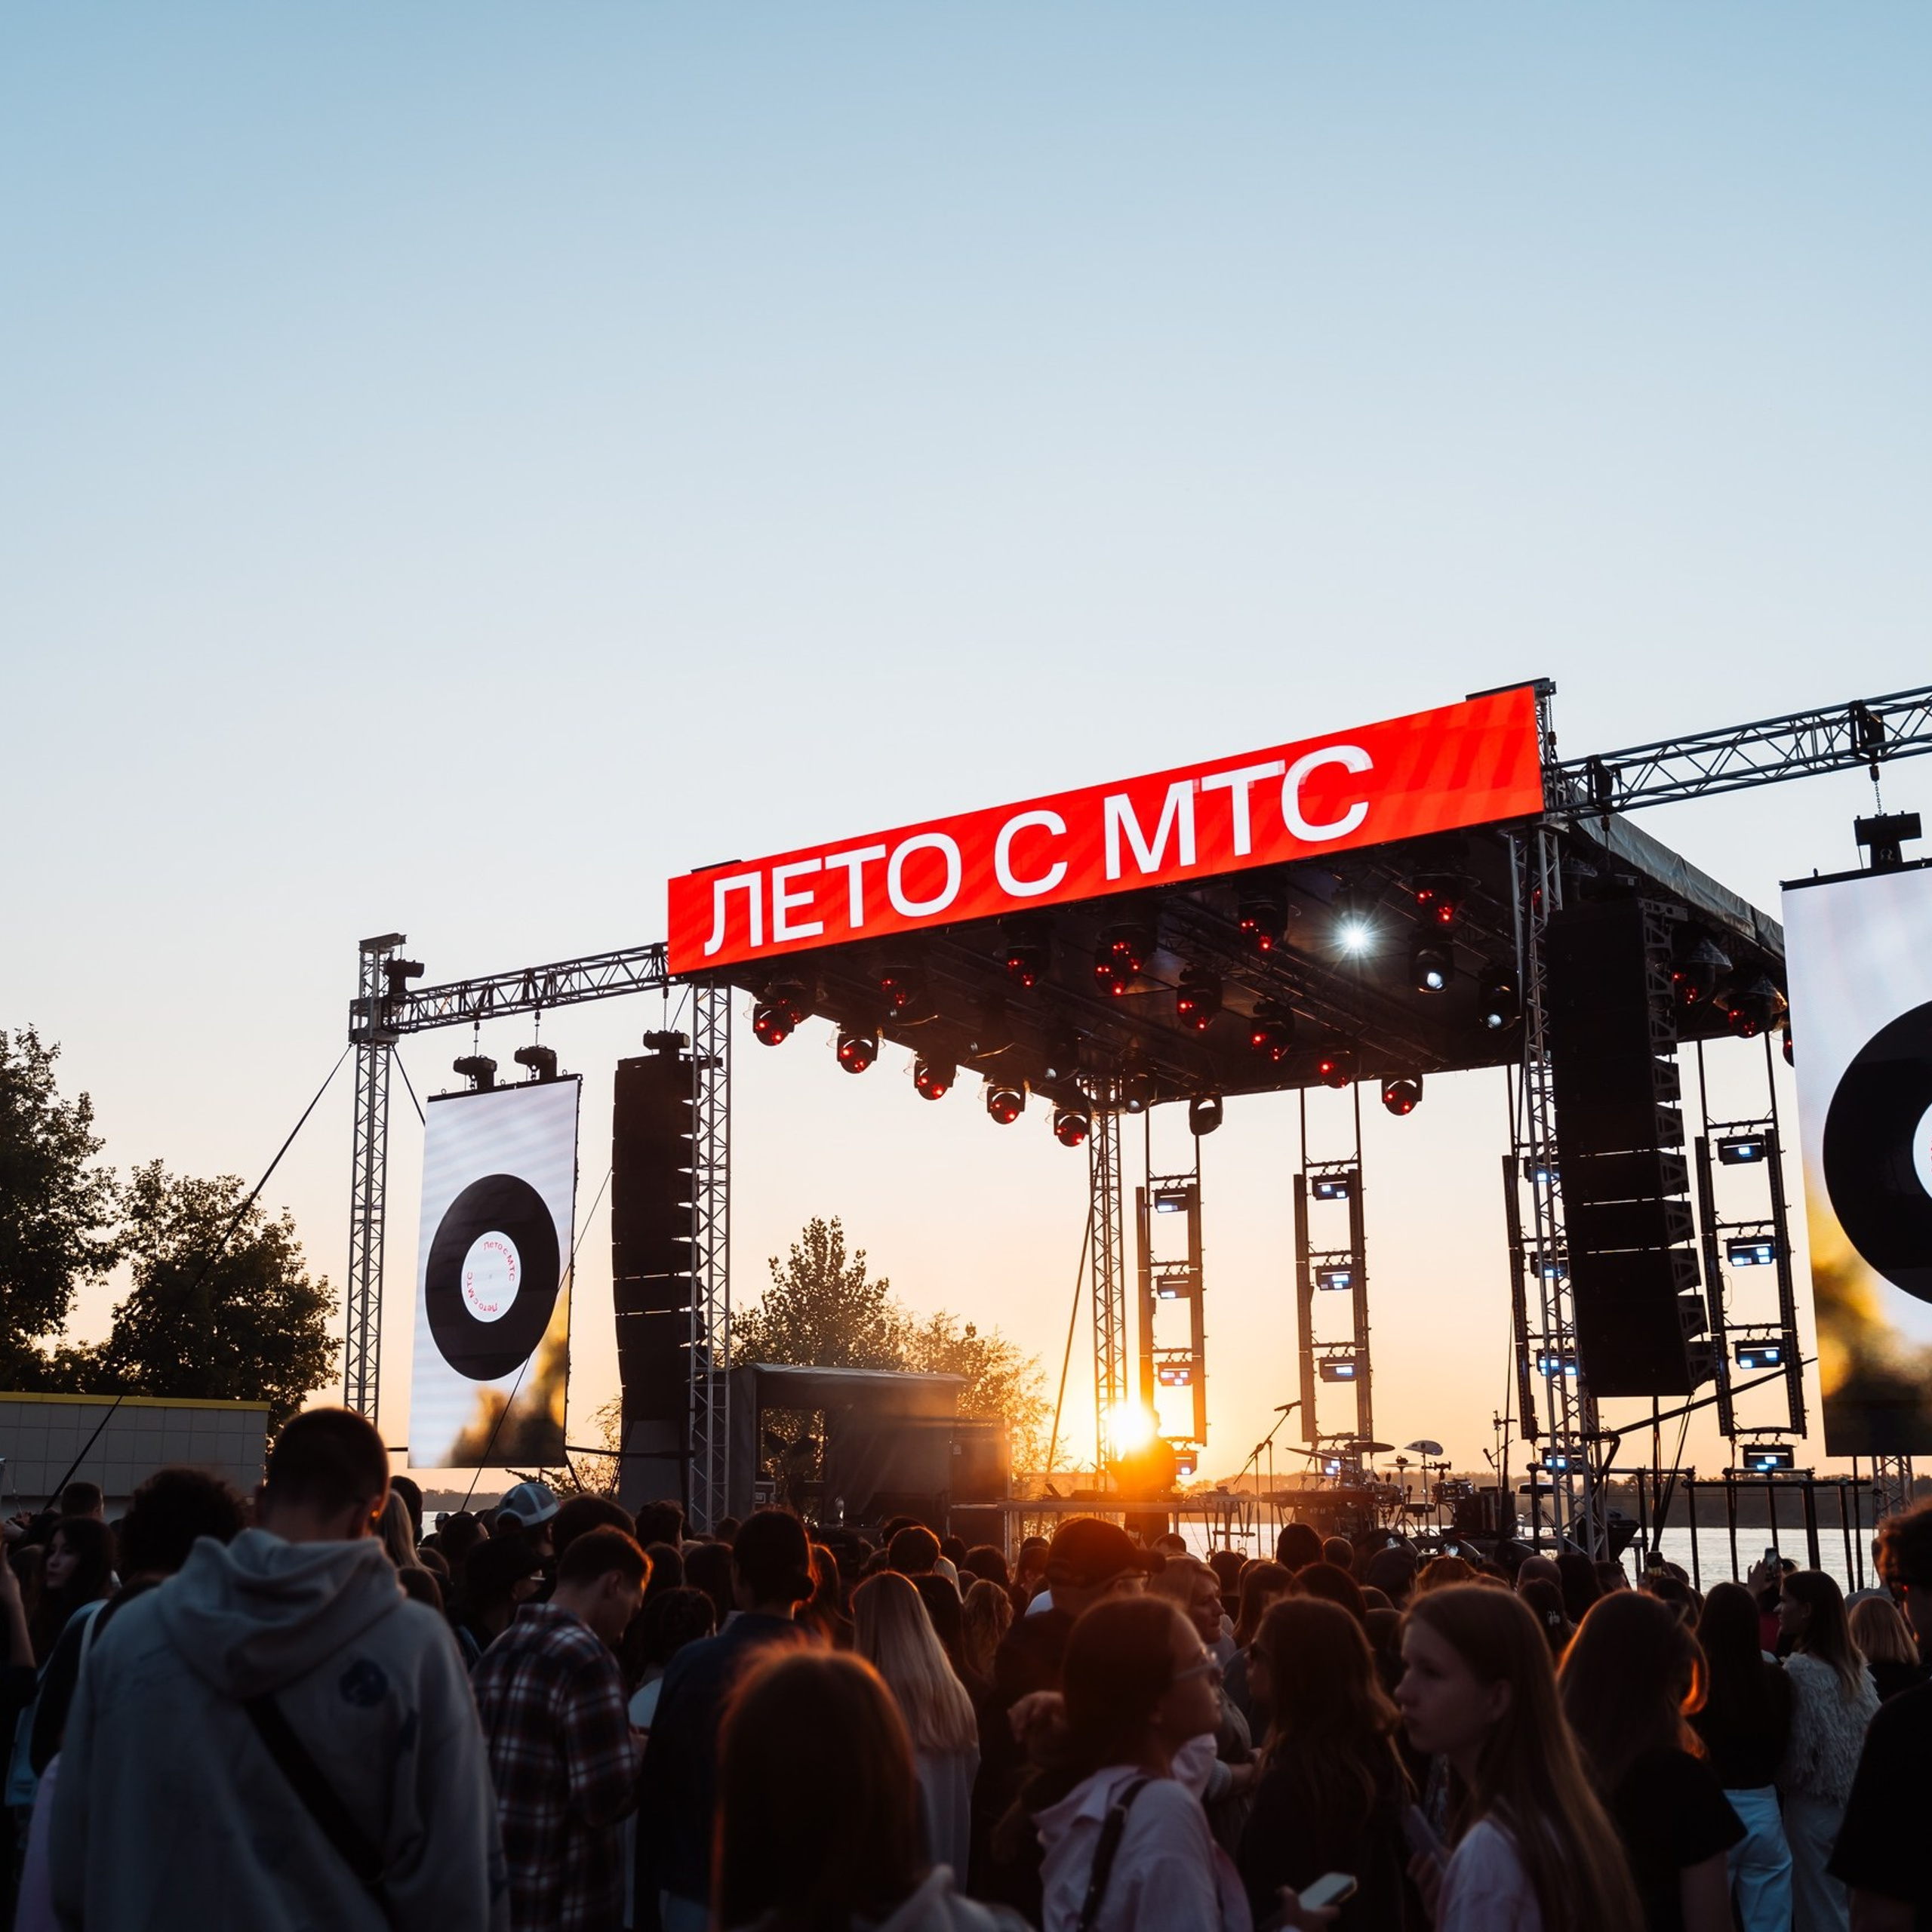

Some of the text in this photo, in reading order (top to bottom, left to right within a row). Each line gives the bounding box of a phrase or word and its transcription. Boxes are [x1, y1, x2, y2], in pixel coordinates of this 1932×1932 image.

[705, 745, 1374, 955] ЛЕТО С МТС
[507, 1254, 515, 1281] МТС
